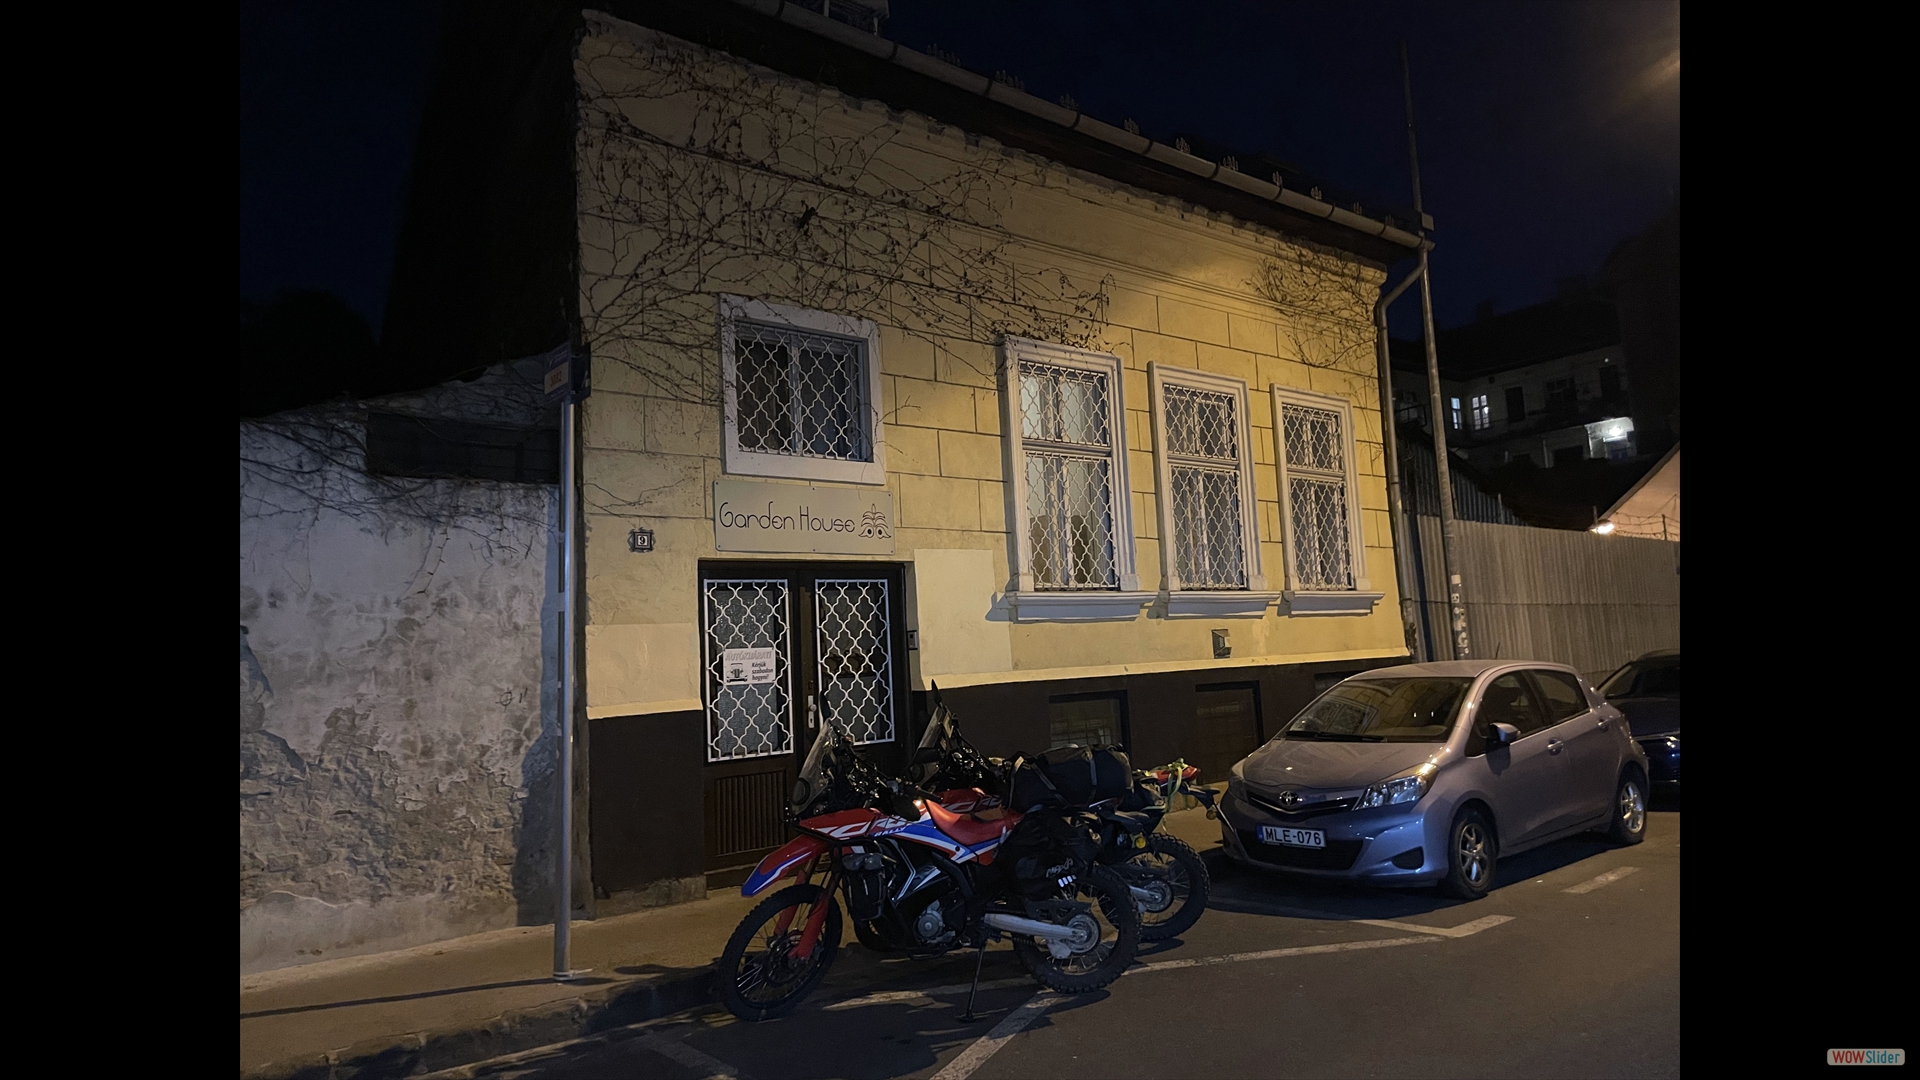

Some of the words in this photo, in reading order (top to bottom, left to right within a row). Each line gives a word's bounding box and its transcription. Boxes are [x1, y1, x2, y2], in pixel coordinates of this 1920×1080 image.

[719, 501, 795, 530] Garden
[799, 505, 856, 533] House
[639, 536, 646, 545] 9
[874, 826, 907, 838] RALLY
[1265, 827, 1321, 845] MLE-076
